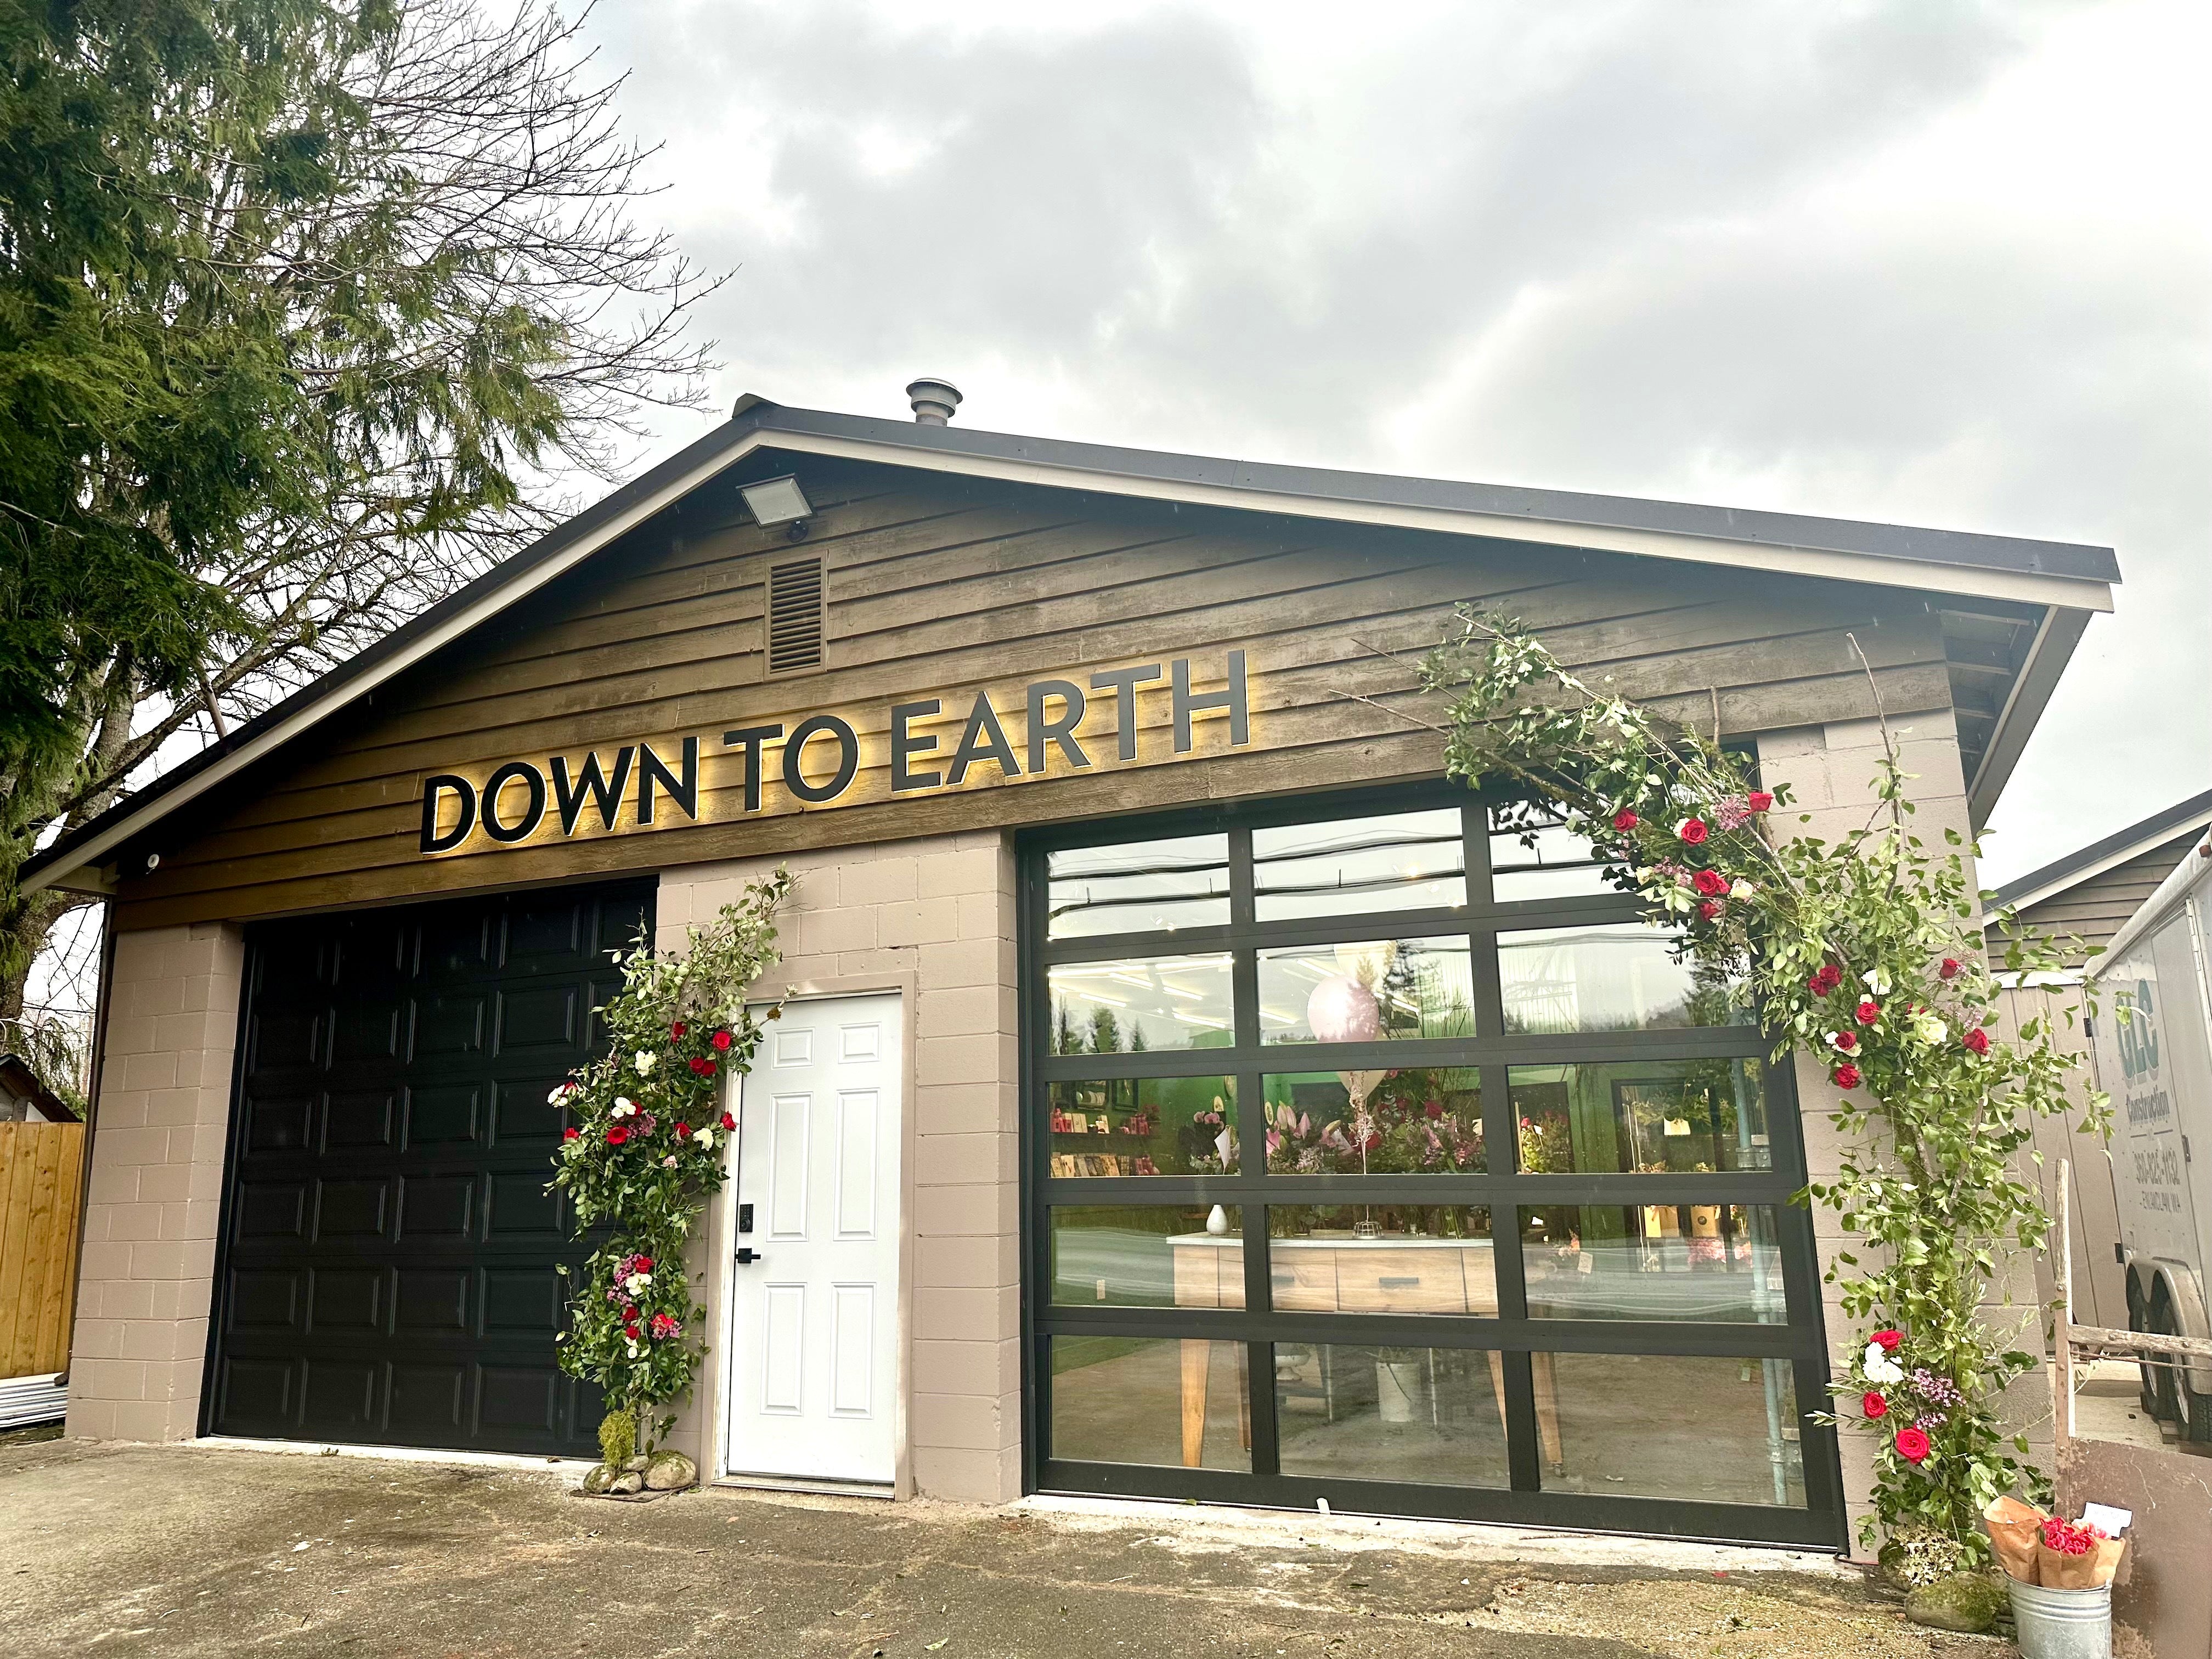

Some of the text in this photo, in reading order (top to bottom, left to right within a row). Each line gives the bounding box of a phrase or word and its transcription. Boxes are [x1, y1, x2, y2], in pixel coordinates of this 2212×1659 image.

[419, 649, 1251, 854] DOWN TO EARTH
[2125, 1085, 2170, 1123] Construction
